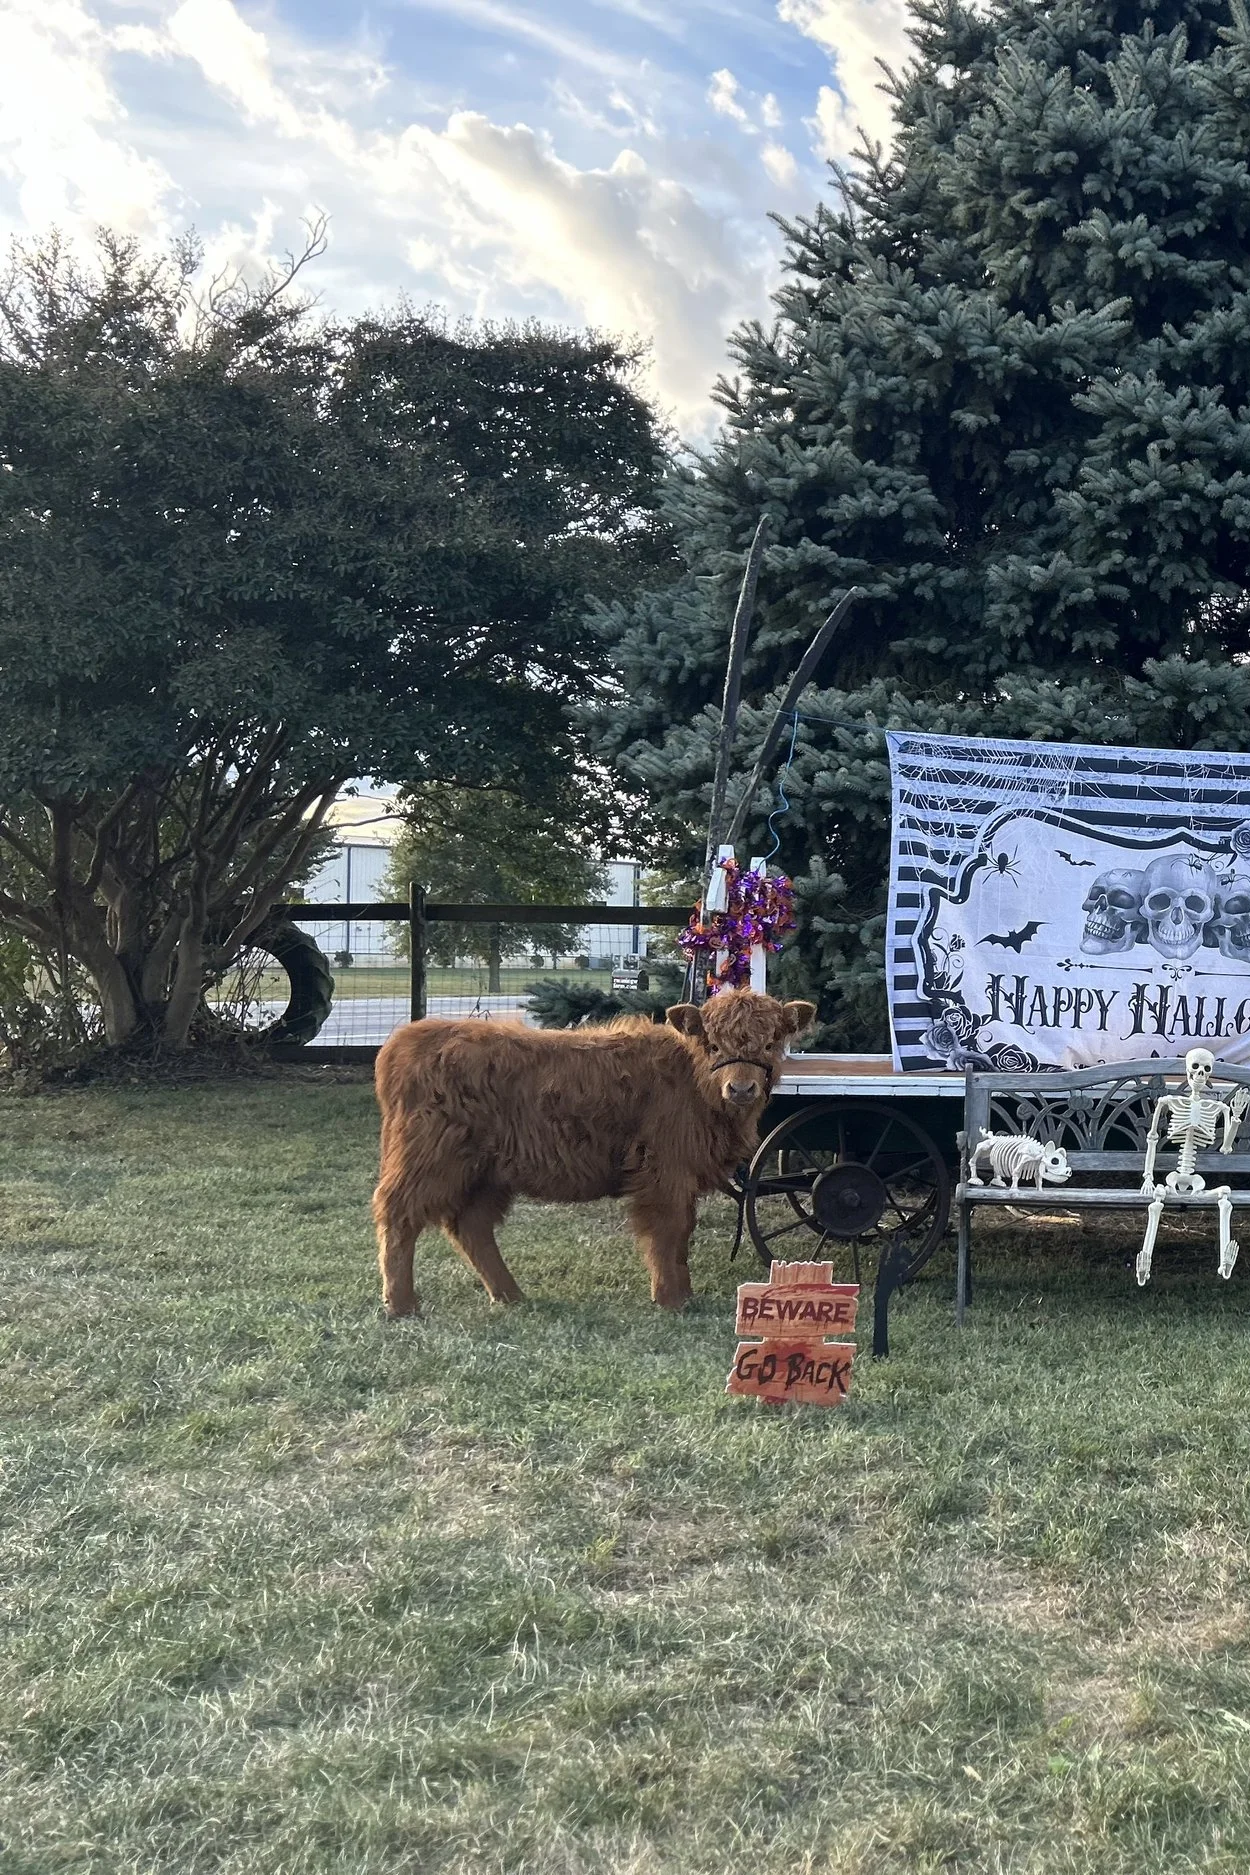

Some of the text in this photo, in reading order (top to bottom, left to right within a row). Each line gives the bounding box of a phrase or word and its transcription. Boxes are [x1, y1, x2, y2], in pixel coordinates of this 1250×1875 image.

[983, 973, 1120, 1034] HAPPY
[741, 1297, 850, 1325] BEWARE
[736, 1349, 850, 1394] GO BACK
